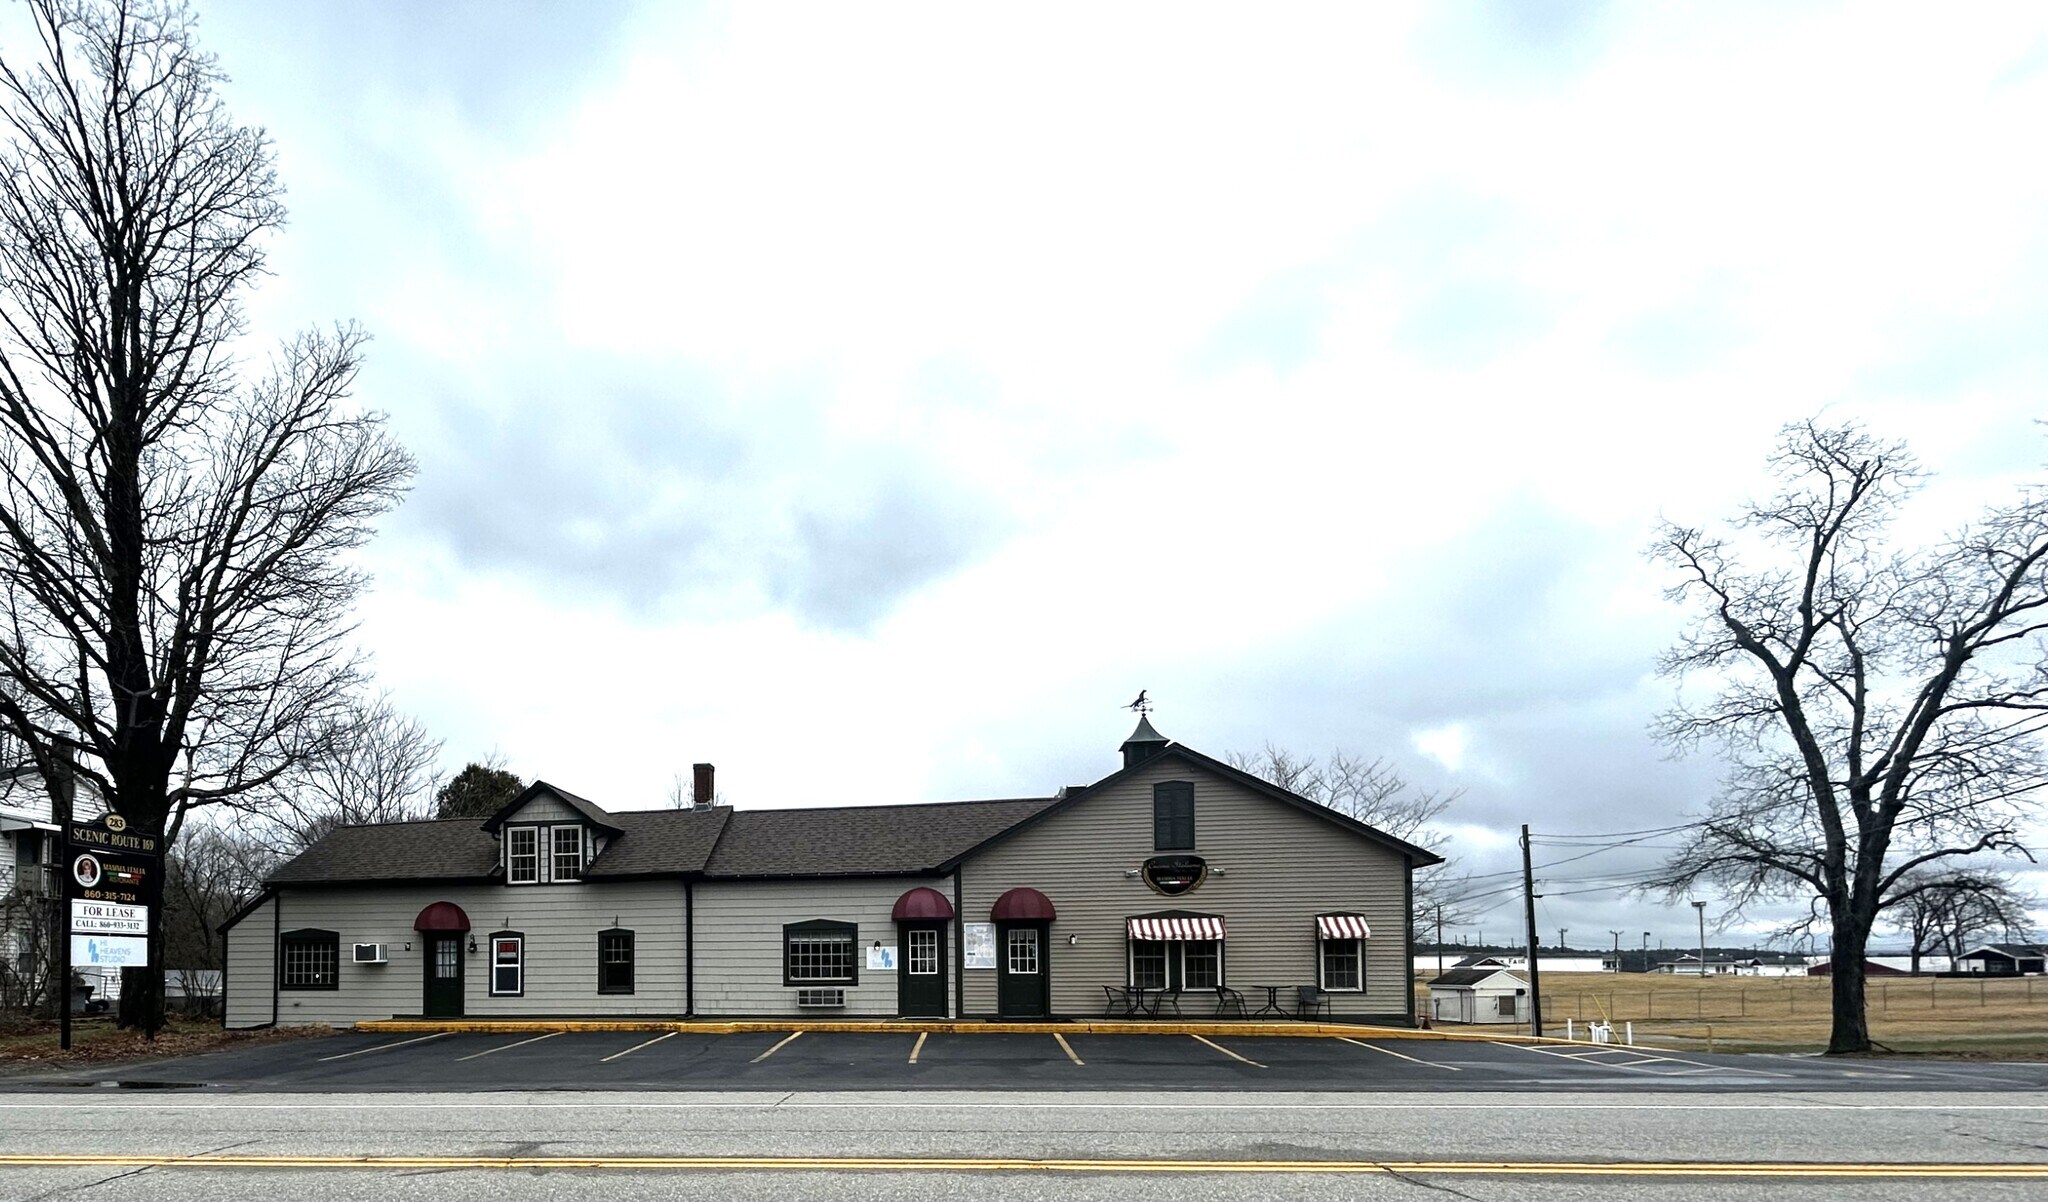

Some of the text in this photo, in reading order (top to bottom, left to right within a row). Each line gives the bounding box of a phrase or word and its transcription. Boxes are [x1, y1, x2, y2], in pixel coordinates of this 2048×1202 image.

[109, 818, 124, 828] 283
[73, 828, 154, 850] SCENIC ROUTE 169
[103, 864, 146, 874] MAMMA ITALIA
[84, 890, 136, 901] 860-315-7124
[84, 906, 136, 918] FOR LEASE
[76, 920, 140, 930] CALL: 860-933-3132
[100, 948, 131, 956] HEAVENS
